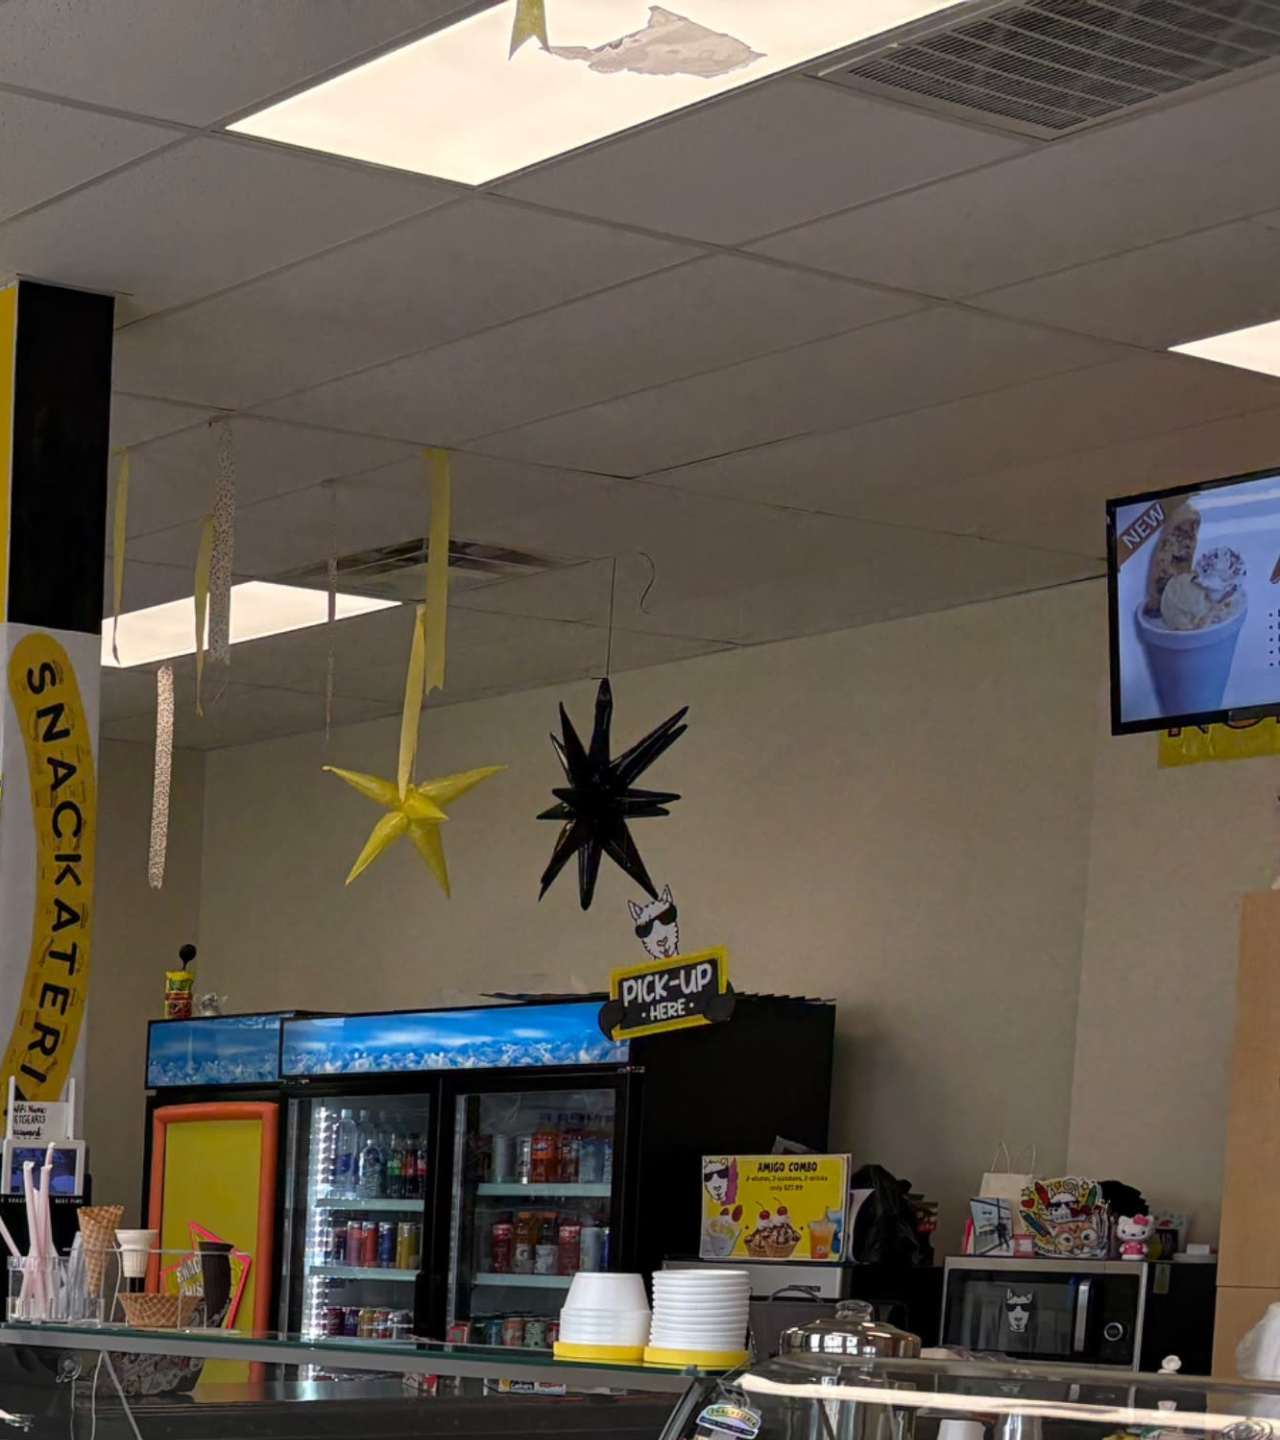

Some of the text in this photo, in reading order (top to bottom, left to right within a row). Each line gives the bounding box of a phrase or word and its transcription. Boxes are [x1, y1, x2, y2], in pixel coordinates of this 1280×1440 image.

[1122, 503, 1165, 550] NEW
[622, 962, 713, 1008] PICK-UP
[649, 998, 686, 1021] HERE
[757, 1161, 818, 1173] AMIGO COMBO
